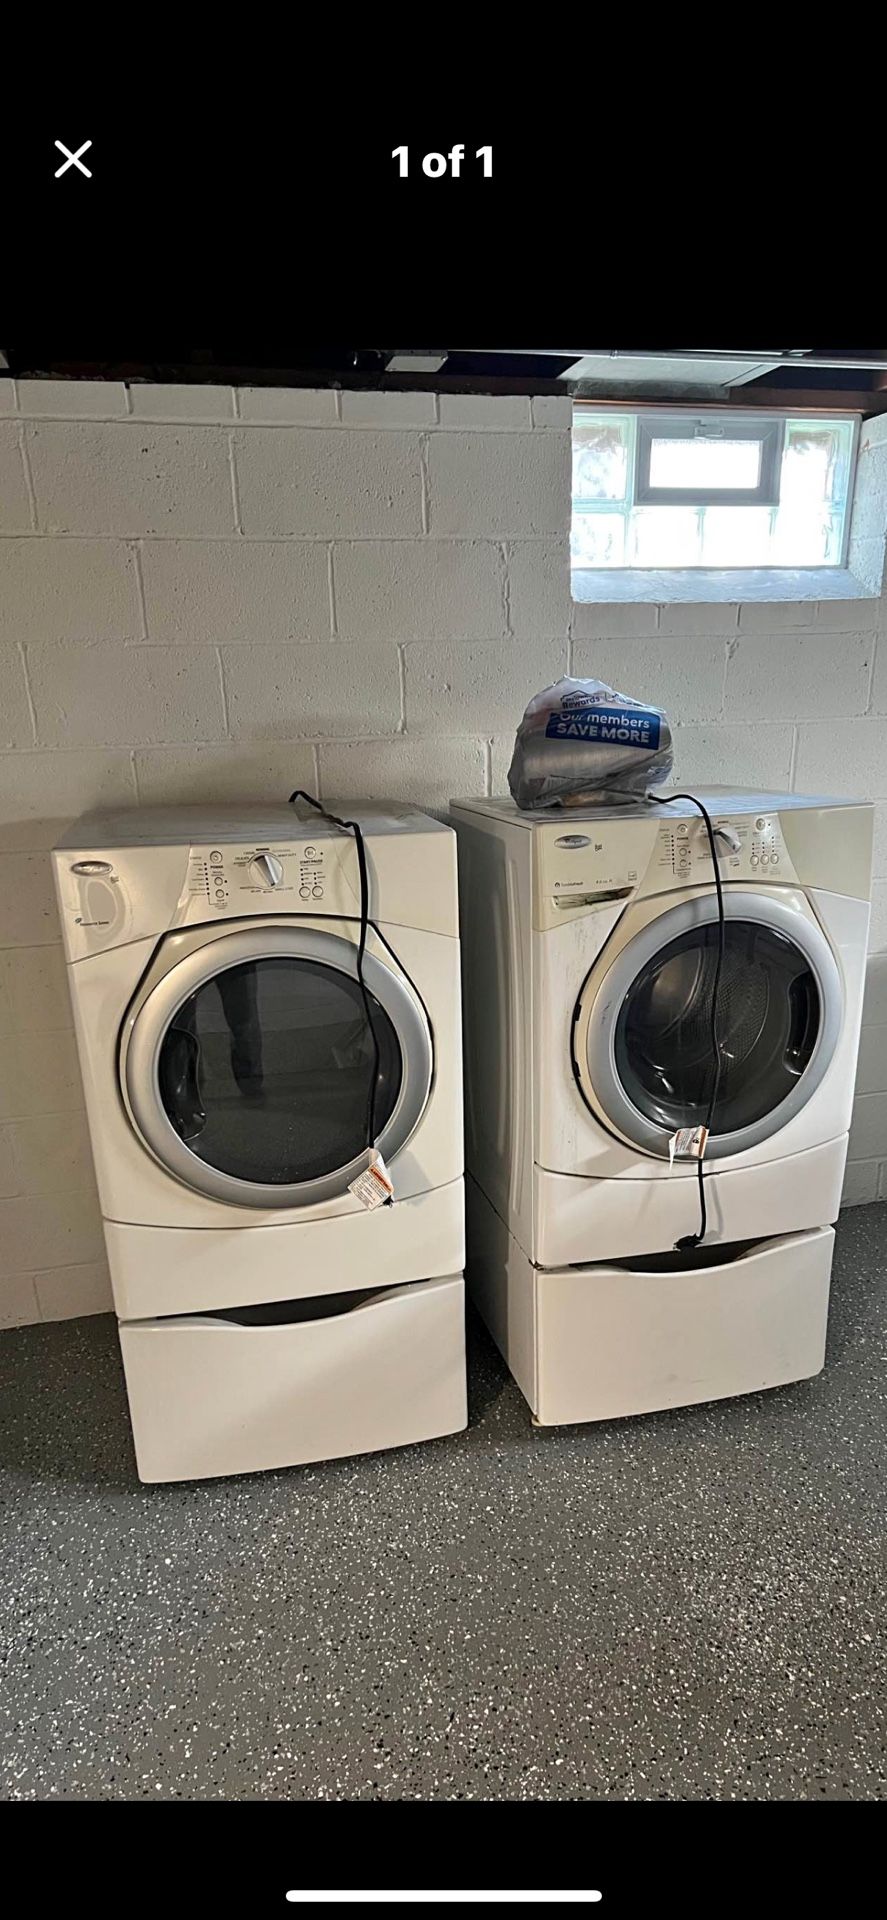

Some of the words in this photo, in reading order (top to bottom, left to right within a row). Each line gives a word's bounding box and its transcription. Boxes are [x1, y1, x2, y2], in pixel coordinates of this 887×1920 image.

[587, 713, 650, 729] members
[556, 723, 599, 737] SAVE
[601, 726, 651, 743] MORE
